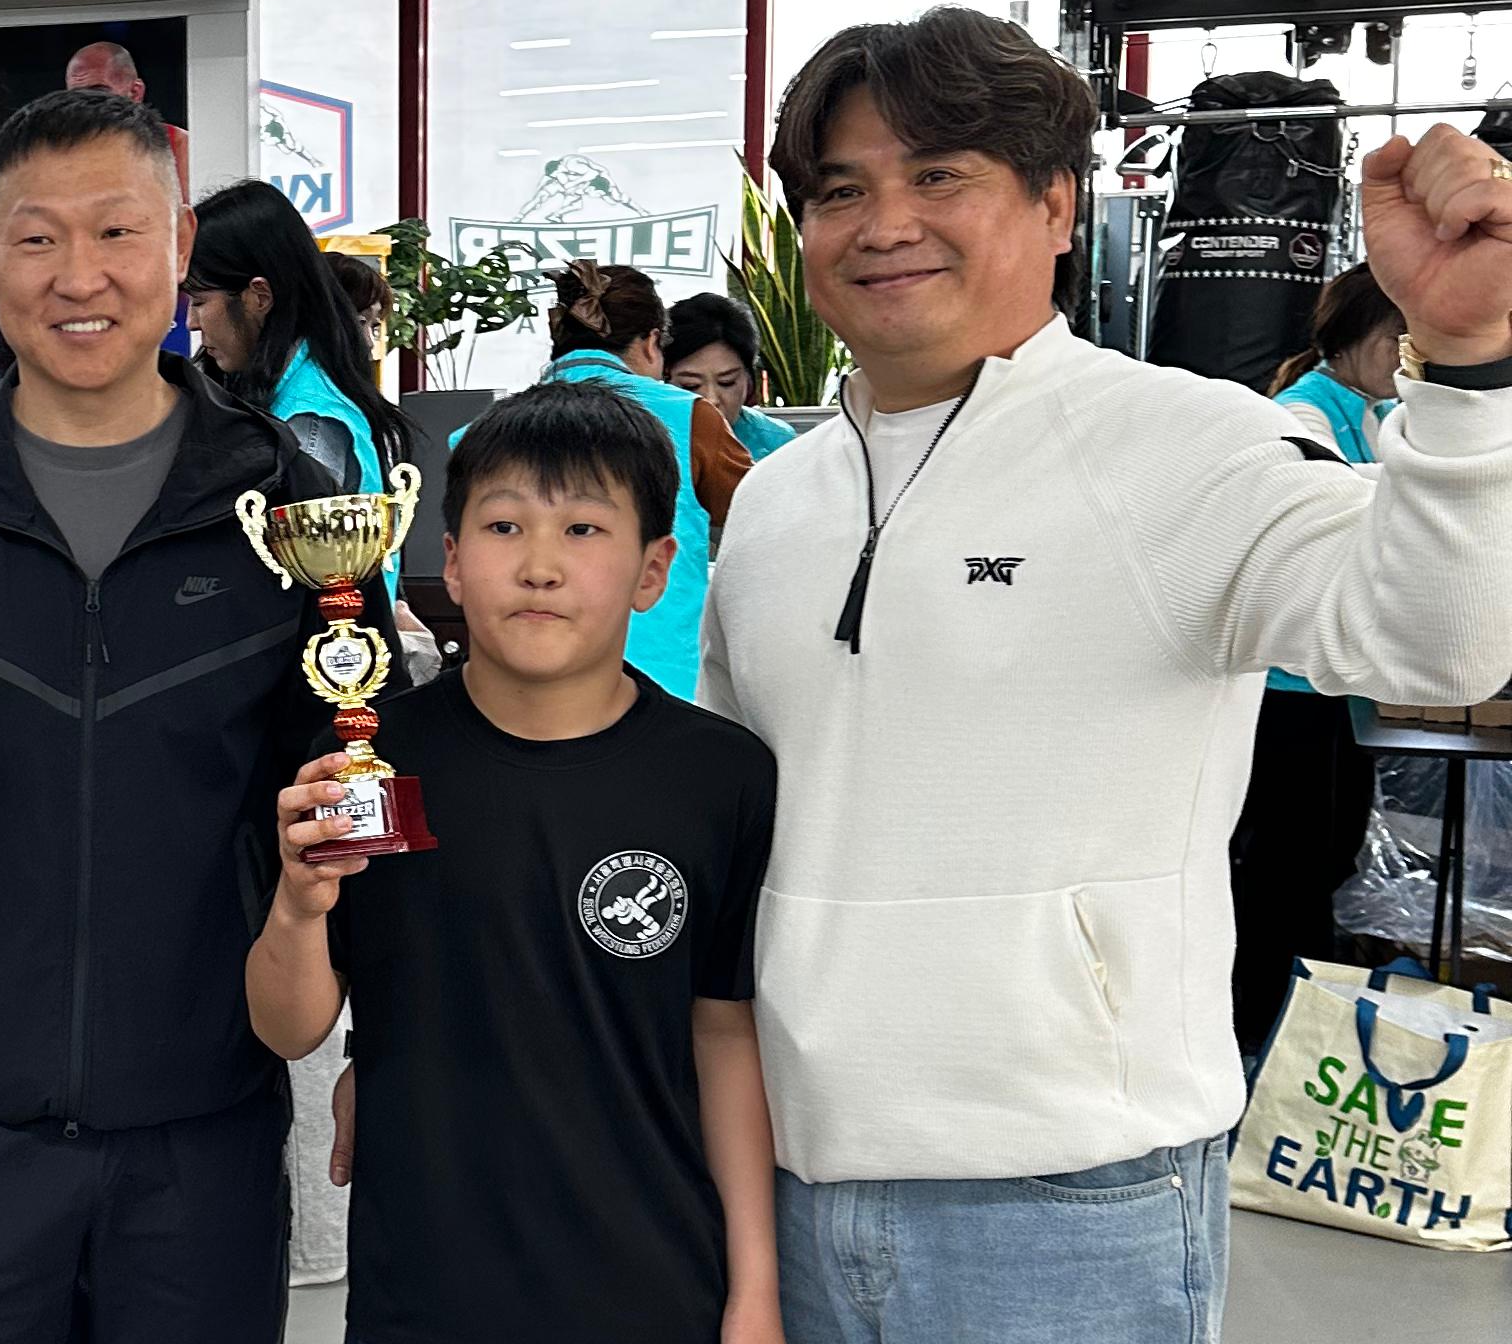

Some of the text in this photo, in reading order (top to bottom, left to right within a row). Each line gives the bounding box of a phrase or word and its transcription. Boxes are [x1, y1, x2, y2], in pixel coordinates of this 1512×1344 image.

[1191, 235, 1280, 250] CONTENDER
[183, 576, 221, 593] NIKE
[963, 557, 1026, 586] PXG
[1329, 1115, 1395, 1172] THE
[1266, 1135, 1473, 1230] EARTH
